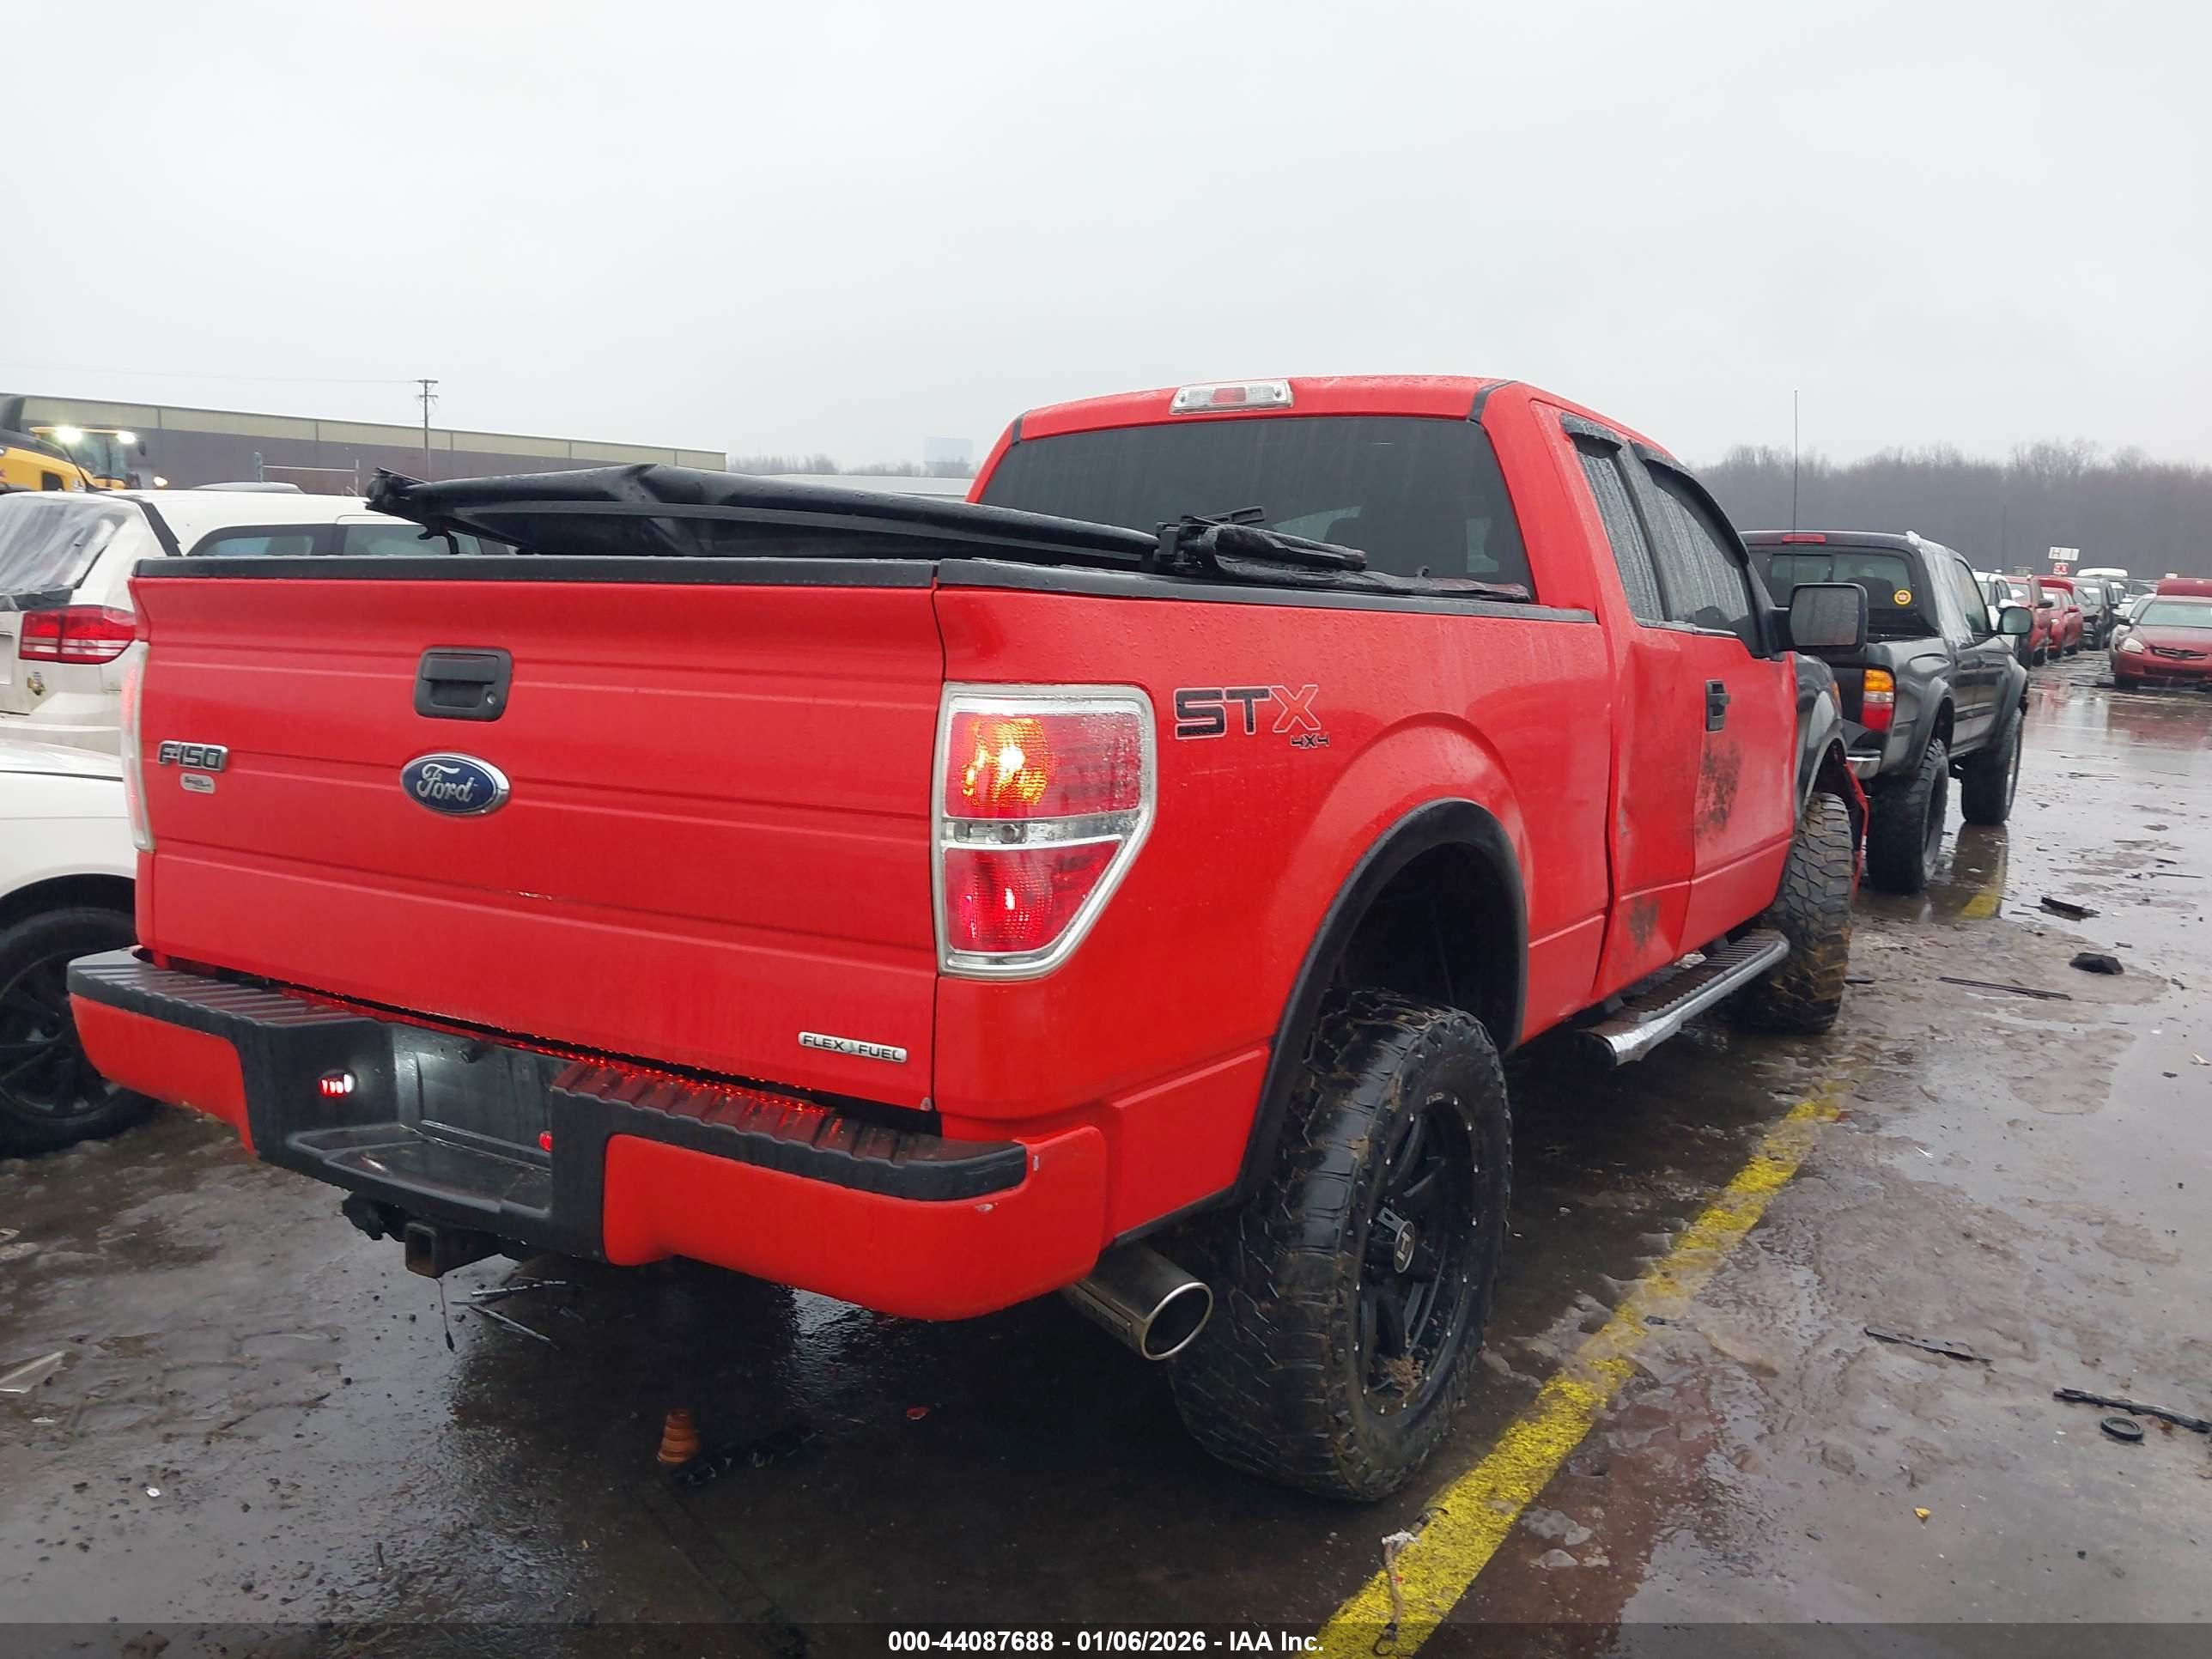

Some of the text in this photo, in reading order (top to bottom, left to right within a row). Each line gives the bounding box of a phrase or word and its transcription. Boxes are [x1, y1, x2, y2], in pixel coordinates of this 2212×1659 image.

[1175, 685, 1322, 740] STX
[416, 763, 476, 802] Ford
[803, 1035, 902, 1061] FLEX FUEL
